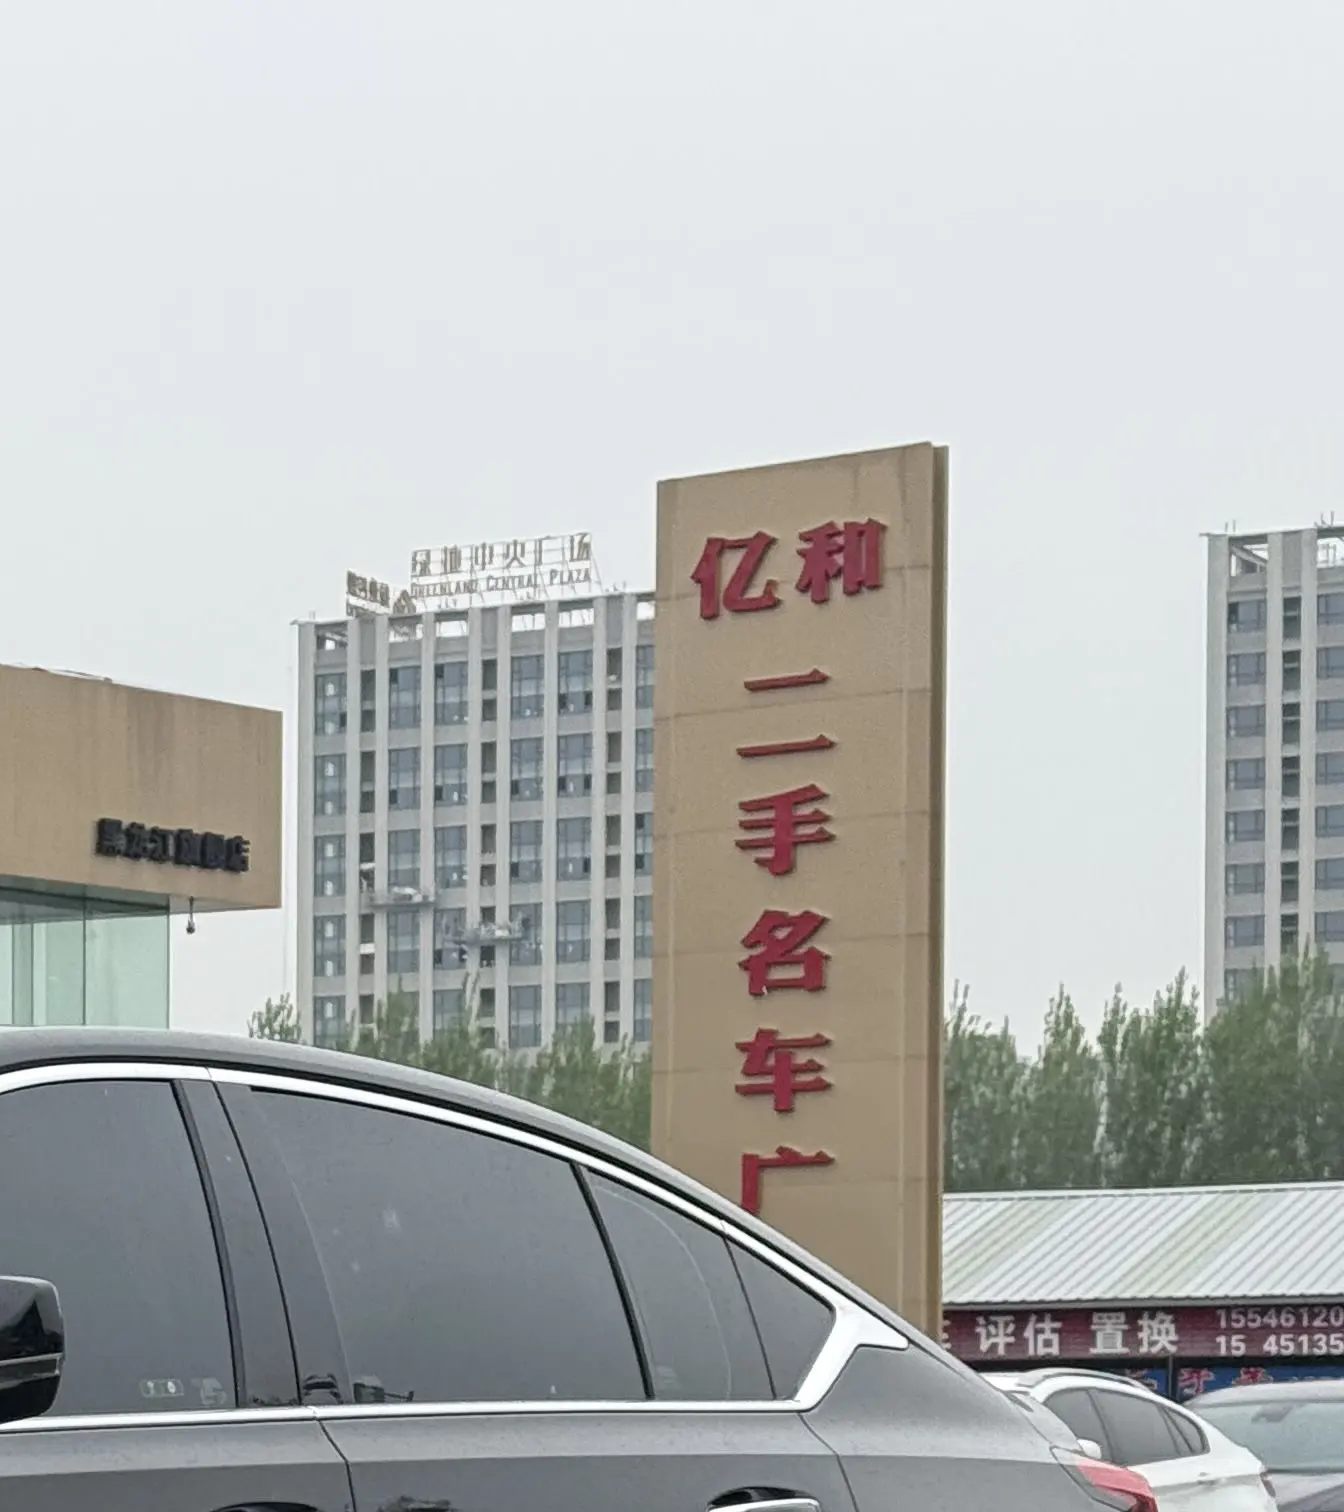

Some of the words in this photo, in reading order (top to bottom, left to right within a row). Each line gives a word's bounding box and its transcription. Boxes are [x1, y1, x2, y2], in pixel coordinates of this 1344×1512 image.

[549, 568, 591, 586] PLAZA
[690, 517, 889, 621] 亿和
[974, 1313, 1063, 1356] 评估
[1089, 1311, 1179, 1355] 置换
